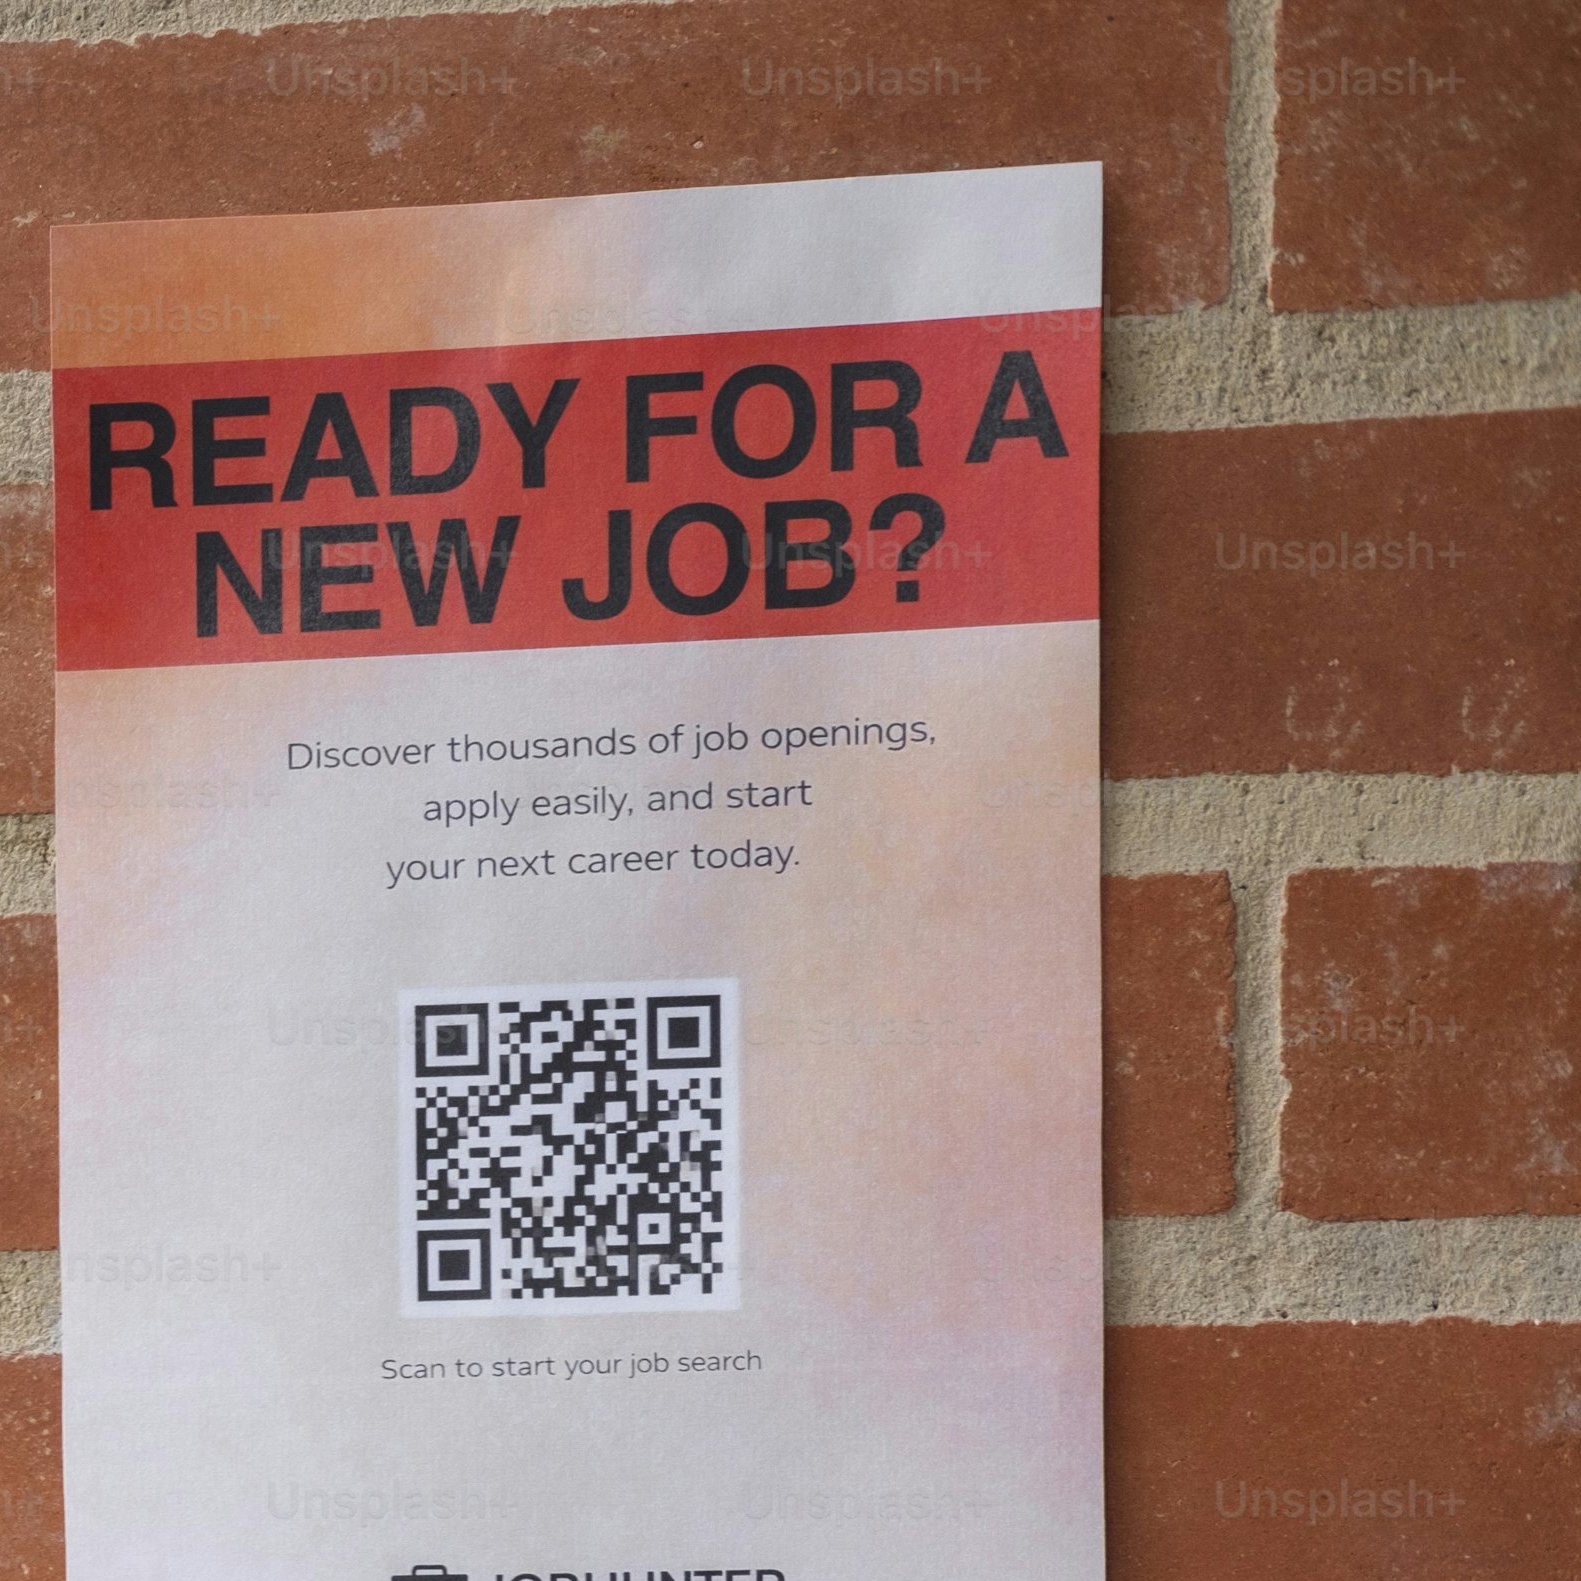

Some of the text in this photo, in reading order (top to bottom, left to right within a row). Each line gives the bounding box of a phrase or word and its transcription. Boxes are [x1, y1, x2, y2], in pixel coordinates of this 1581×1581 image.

[88, 349, 1070, 511] READY FOR A
[192, 492, 946, 638] NEW JOB?
[287, 721, 935, 770] Discover thousands of job openings,
[423, 780, 813, 828] apply easily, and start
[386, 838, 799, 890] your next career today.
[381, 1349, 762, 1381] Scan to start your job search
